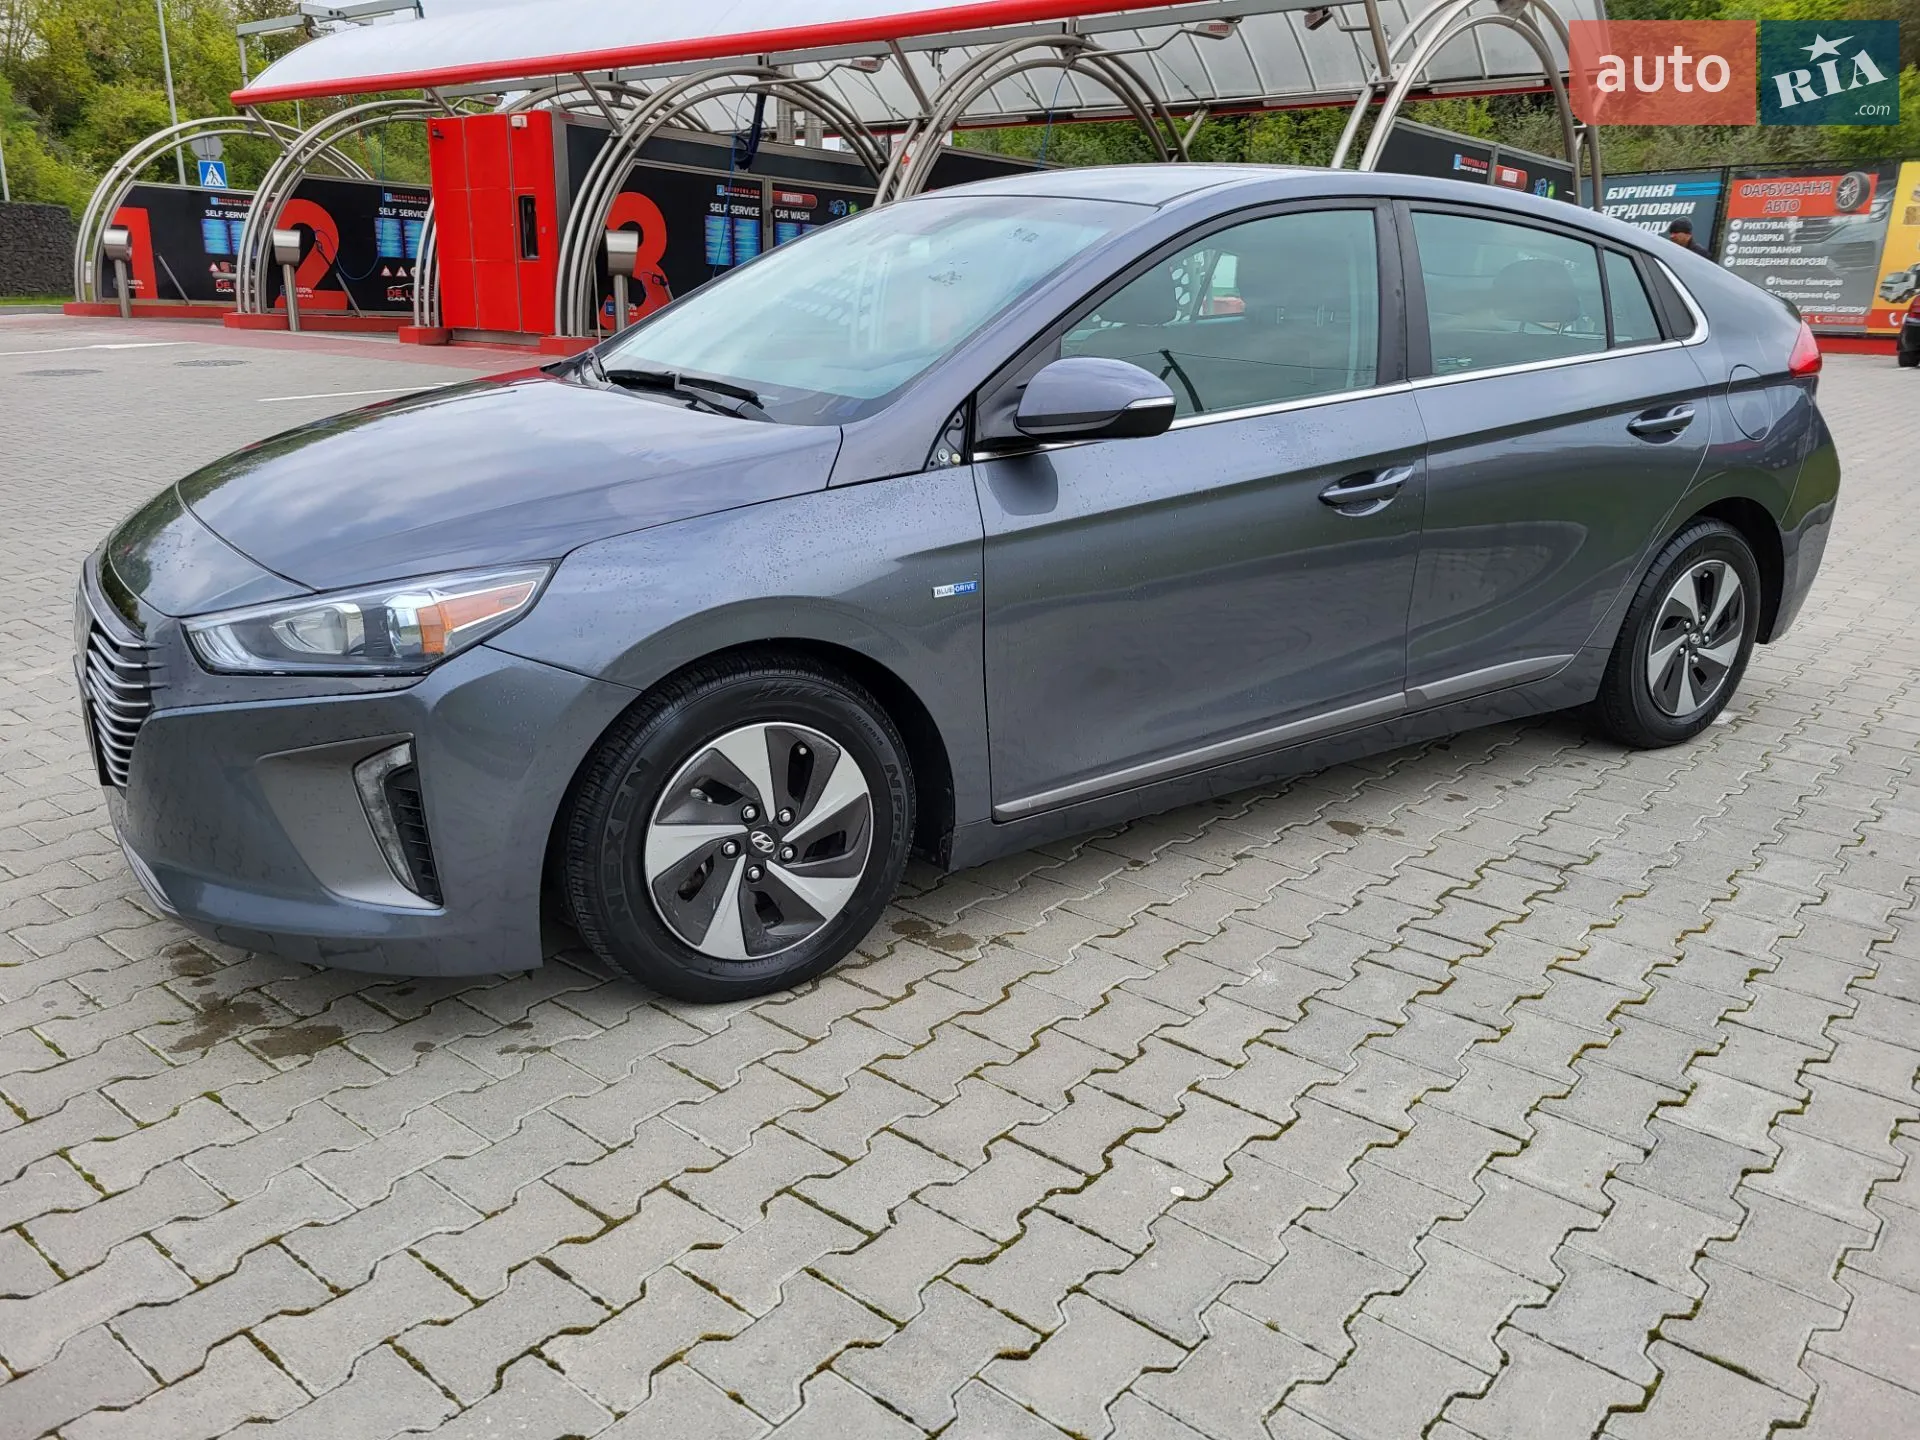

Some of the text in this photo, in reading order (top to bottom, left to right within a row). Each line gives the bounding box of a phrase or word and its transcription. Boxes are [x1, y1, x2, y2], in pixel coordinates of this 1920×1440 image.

[1606, 184, 1677, 200] БУРІННЯ
[1740, 180, 1832, 197] ФАРБУВАННЯ
[379, 207, 397, 216] SELF
[710, 202, 760, 216] SELF SERVICE
[1588, 202, 1696, 219] ВЕРДЛОВИН
[1763, 198, 1800, 214] АВТО
[205, 209, 250, 219] SELF SERVIC
[775, 209, 810, 220] CAR WASH
[1743, 220, 1804, 230] РИХТУВАННЯ
[1741, 233, 1785, 242] МАЛЯРКА
[274, 198, 340, 309] 2
[1738, 245, 1802, 254] ПОЛІРУВАННЯ
[1735, 257, 1789, 267] ВИВЕДЕННЯ
[603, 757, 655, 923] NEXEN
